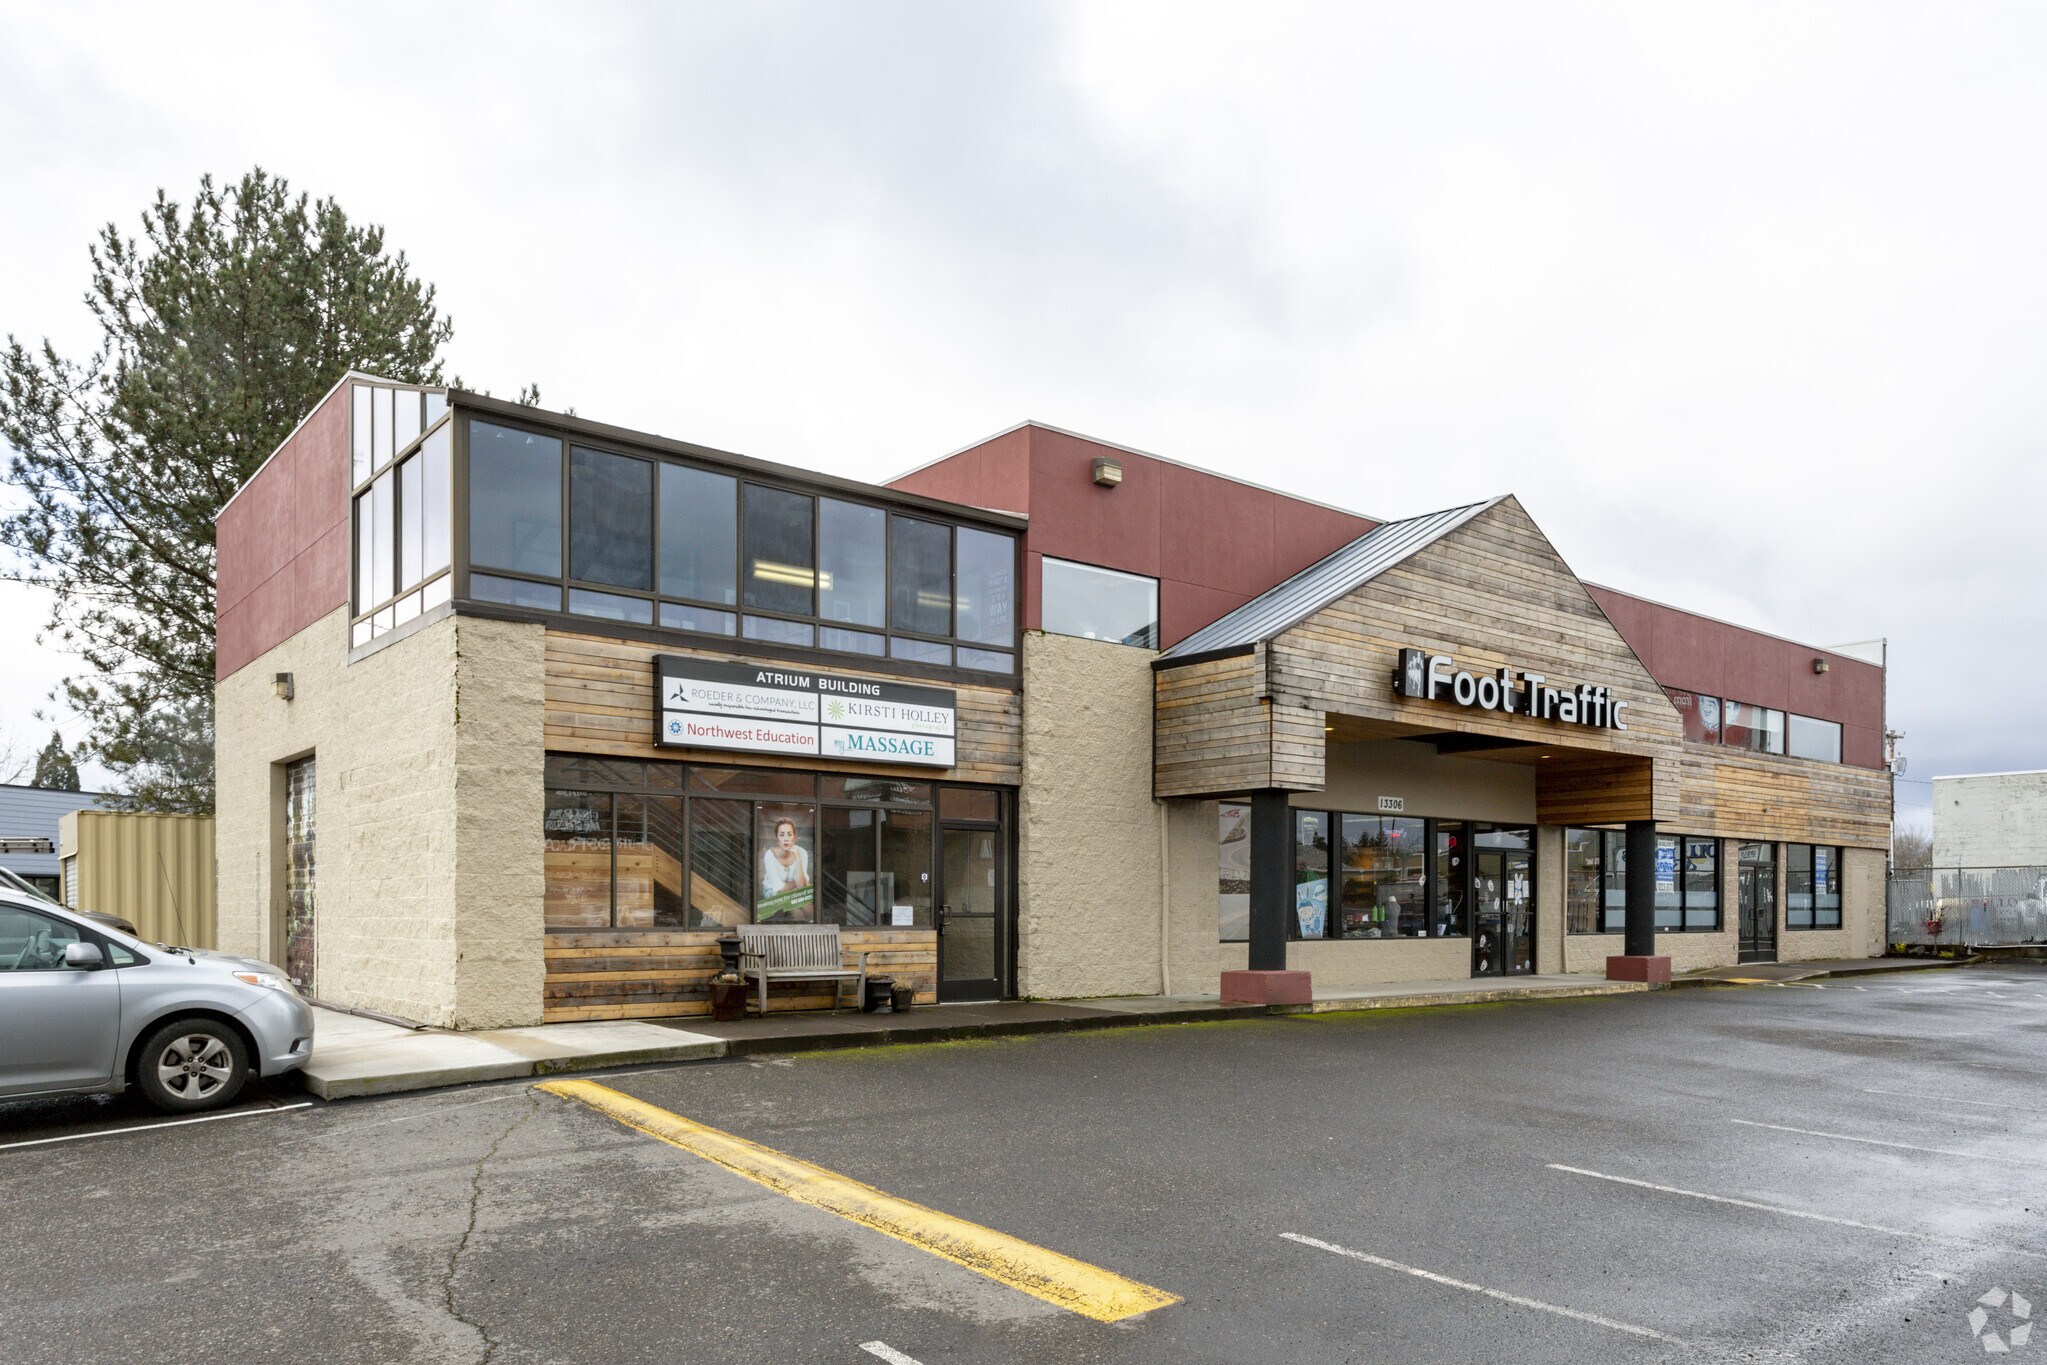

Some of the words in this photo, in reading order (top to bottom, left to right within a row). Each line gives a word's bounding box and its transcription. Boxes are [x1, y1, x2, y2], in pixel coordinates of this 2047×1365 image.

[989, 601, 1008, 617] WAY
[756, 671, 810, 688] ATRIUM
[818, 678, 881, 696] BUILDING
[1427, 655, 1514, 714] Foot
[1523, 671, 1630, 730] Traffic
[691, 688, 734, 702] ROEDER
[735, 694, 743, 702] &
[745, 694, 797, 709] COMPANY,
[798, 701, 815, 711] LLC
[848, 702, 896, 719] KIRSTI
[901, 708, 950, 725] HOLLEY
[687, 723, 753, 741] Northwest
[756, 729, 814, 746] Education
[833, 738, 846, 755] my
[847, 734, 935, 757] MASSAGE
[1380, 798, 1403, 810] 13306
